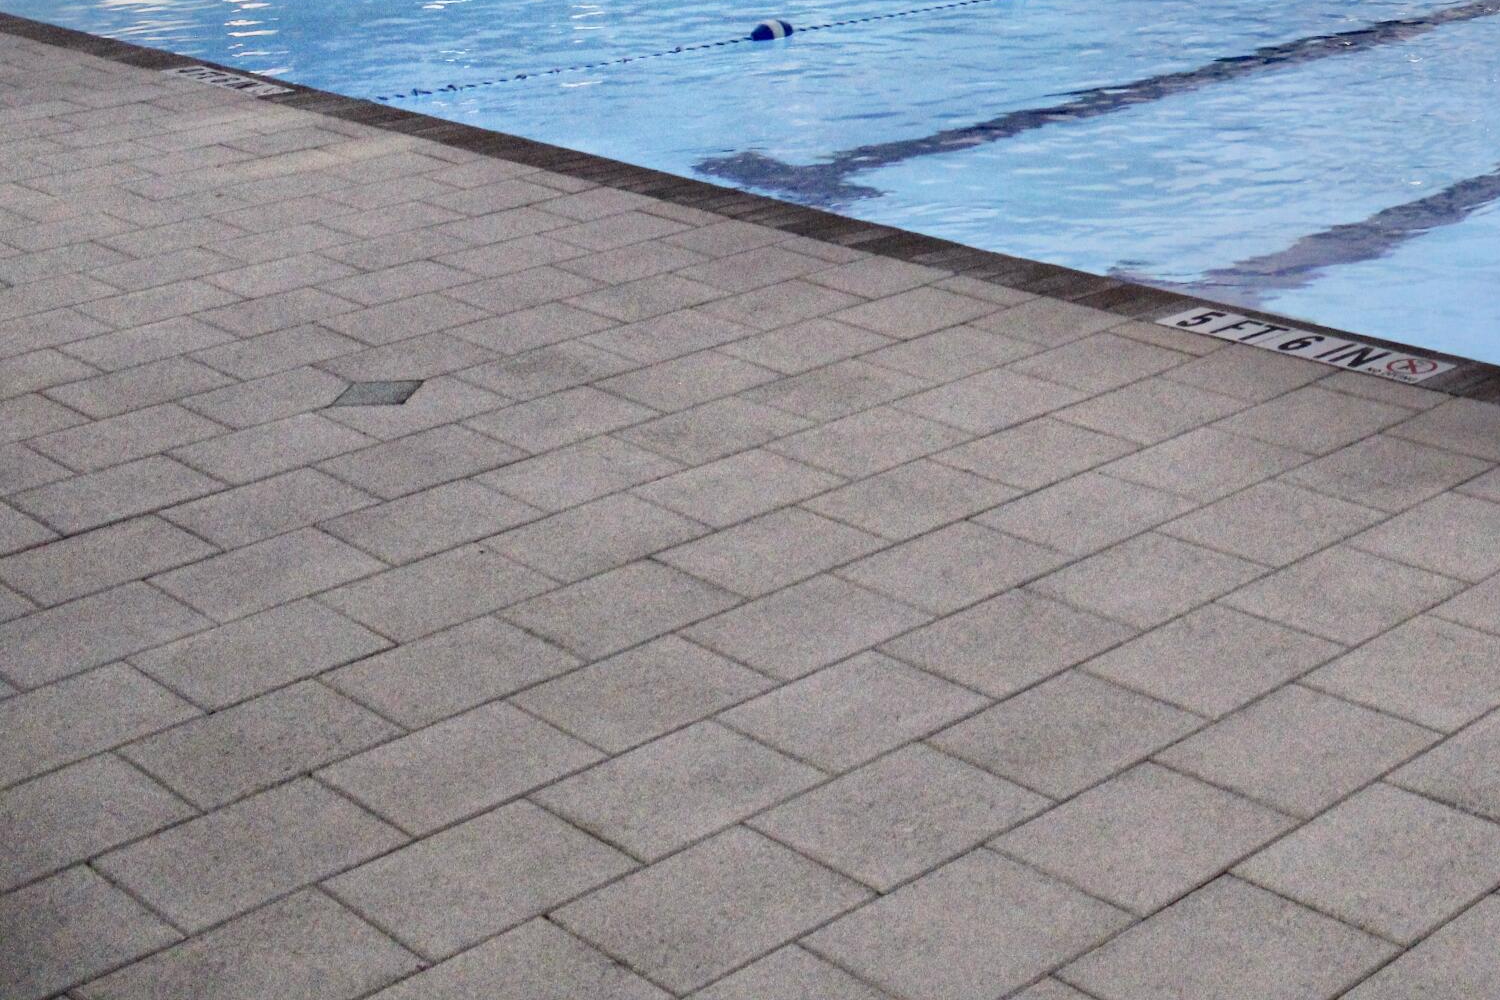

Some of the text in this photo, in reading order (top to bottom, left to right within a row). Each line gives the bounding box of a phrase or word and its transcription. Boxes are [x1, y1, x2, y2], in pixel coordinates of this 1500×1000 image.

[1176, 311, 1392, 367] 5 FT 6 IN
